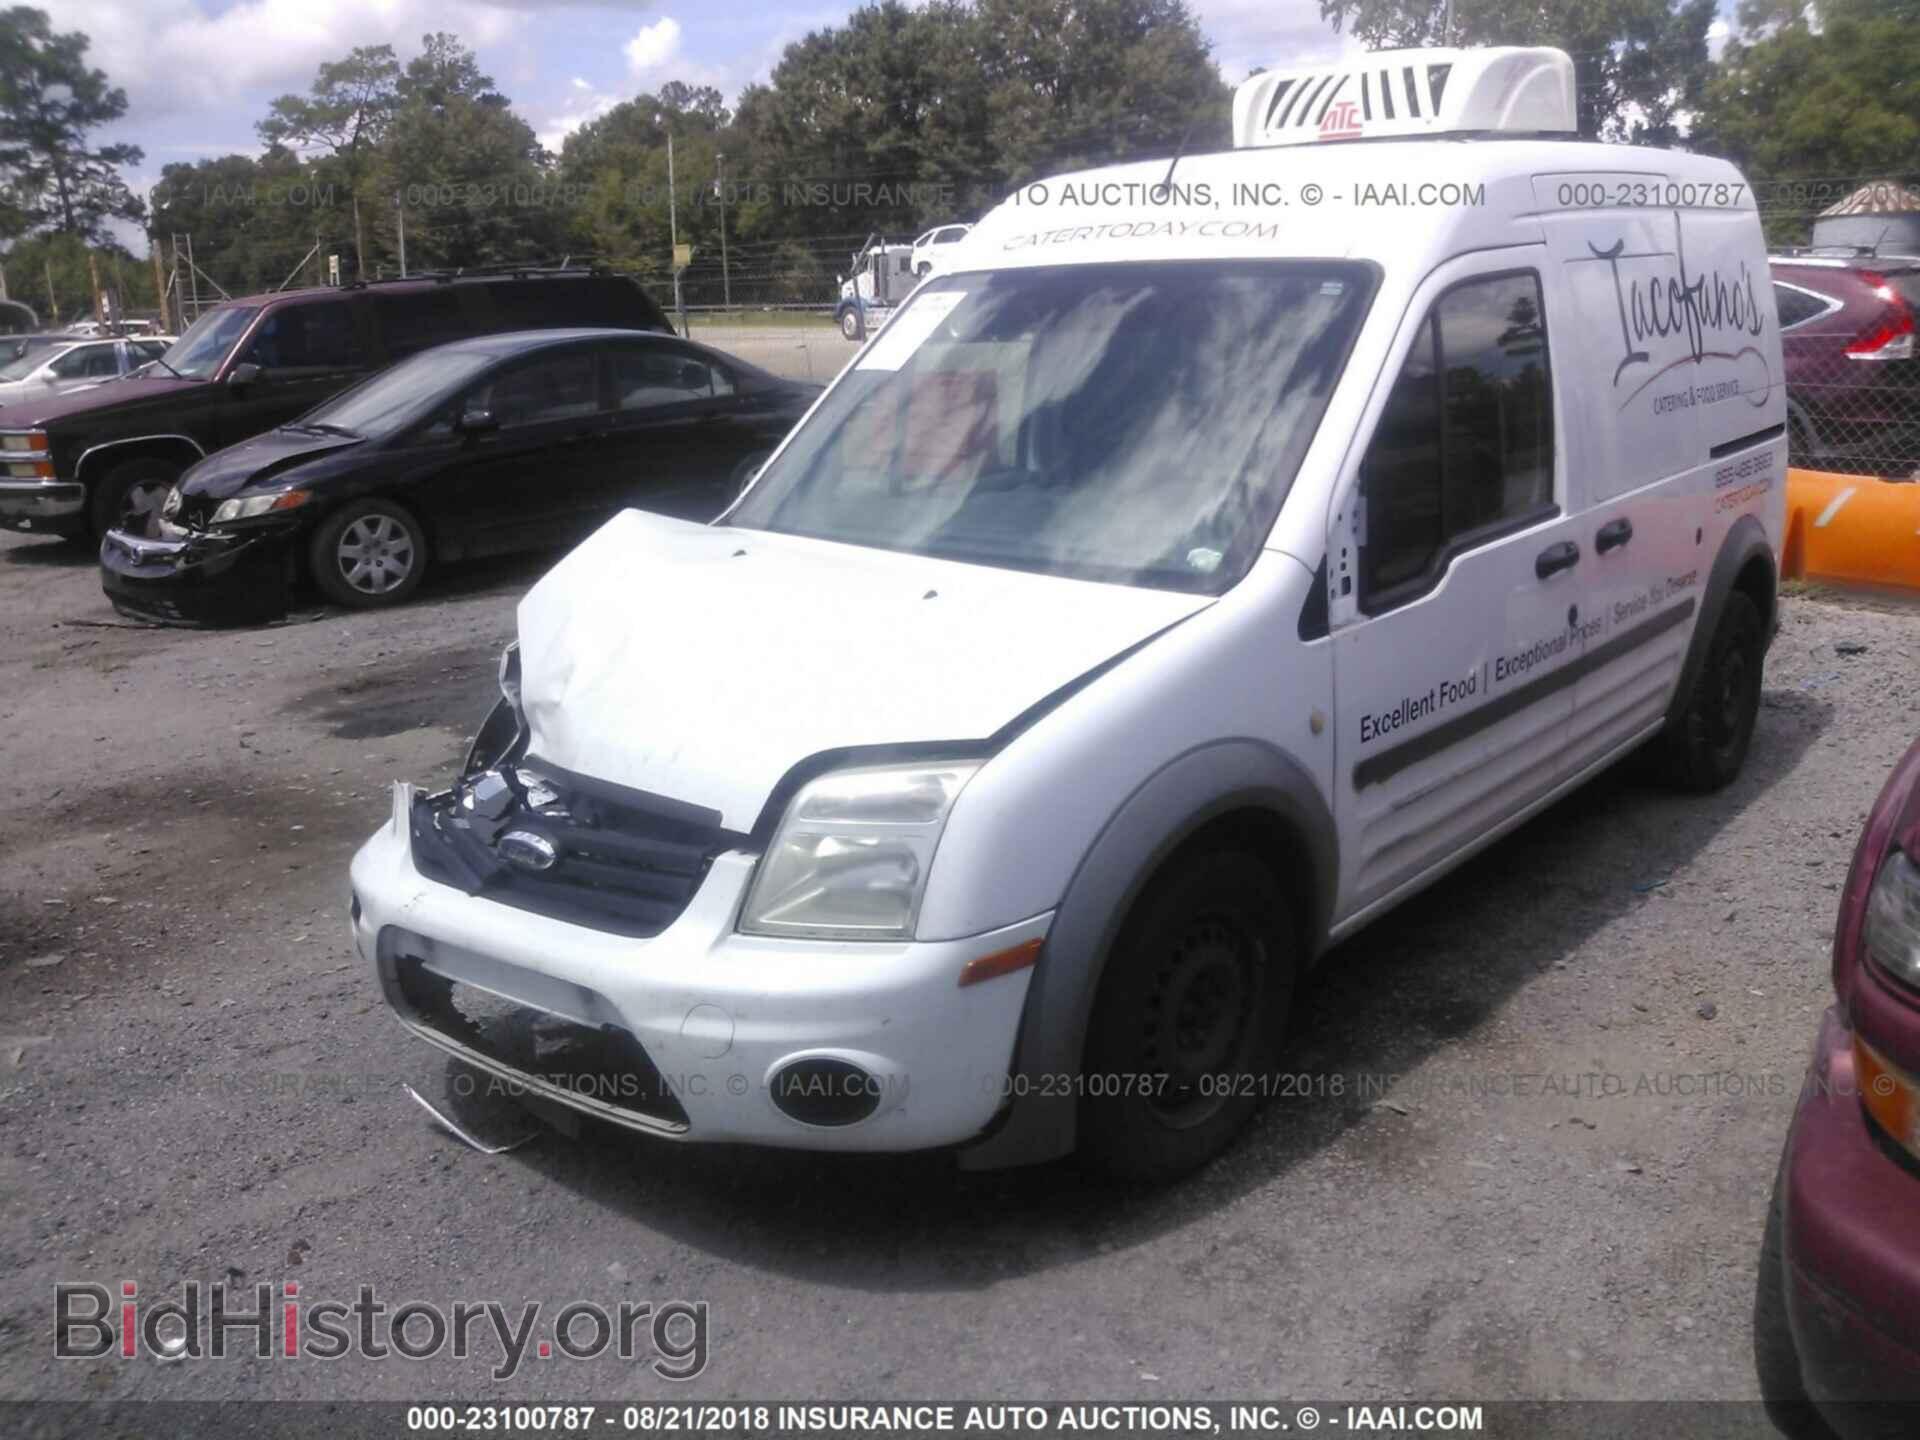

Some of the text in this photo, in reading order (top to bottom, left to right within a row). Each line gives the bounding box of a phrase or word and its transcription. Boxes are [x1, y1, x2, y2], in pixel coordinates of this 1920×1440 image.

[1320, 102, 1363, 131] ATC
[1003, 221, 1279, 251] CATERTODAYCOM
[1361, 688, 1436, 744] Excellent
[1440, 671, 1476, 708] Food
[1495, 628, 1567, 682] Exceptional
